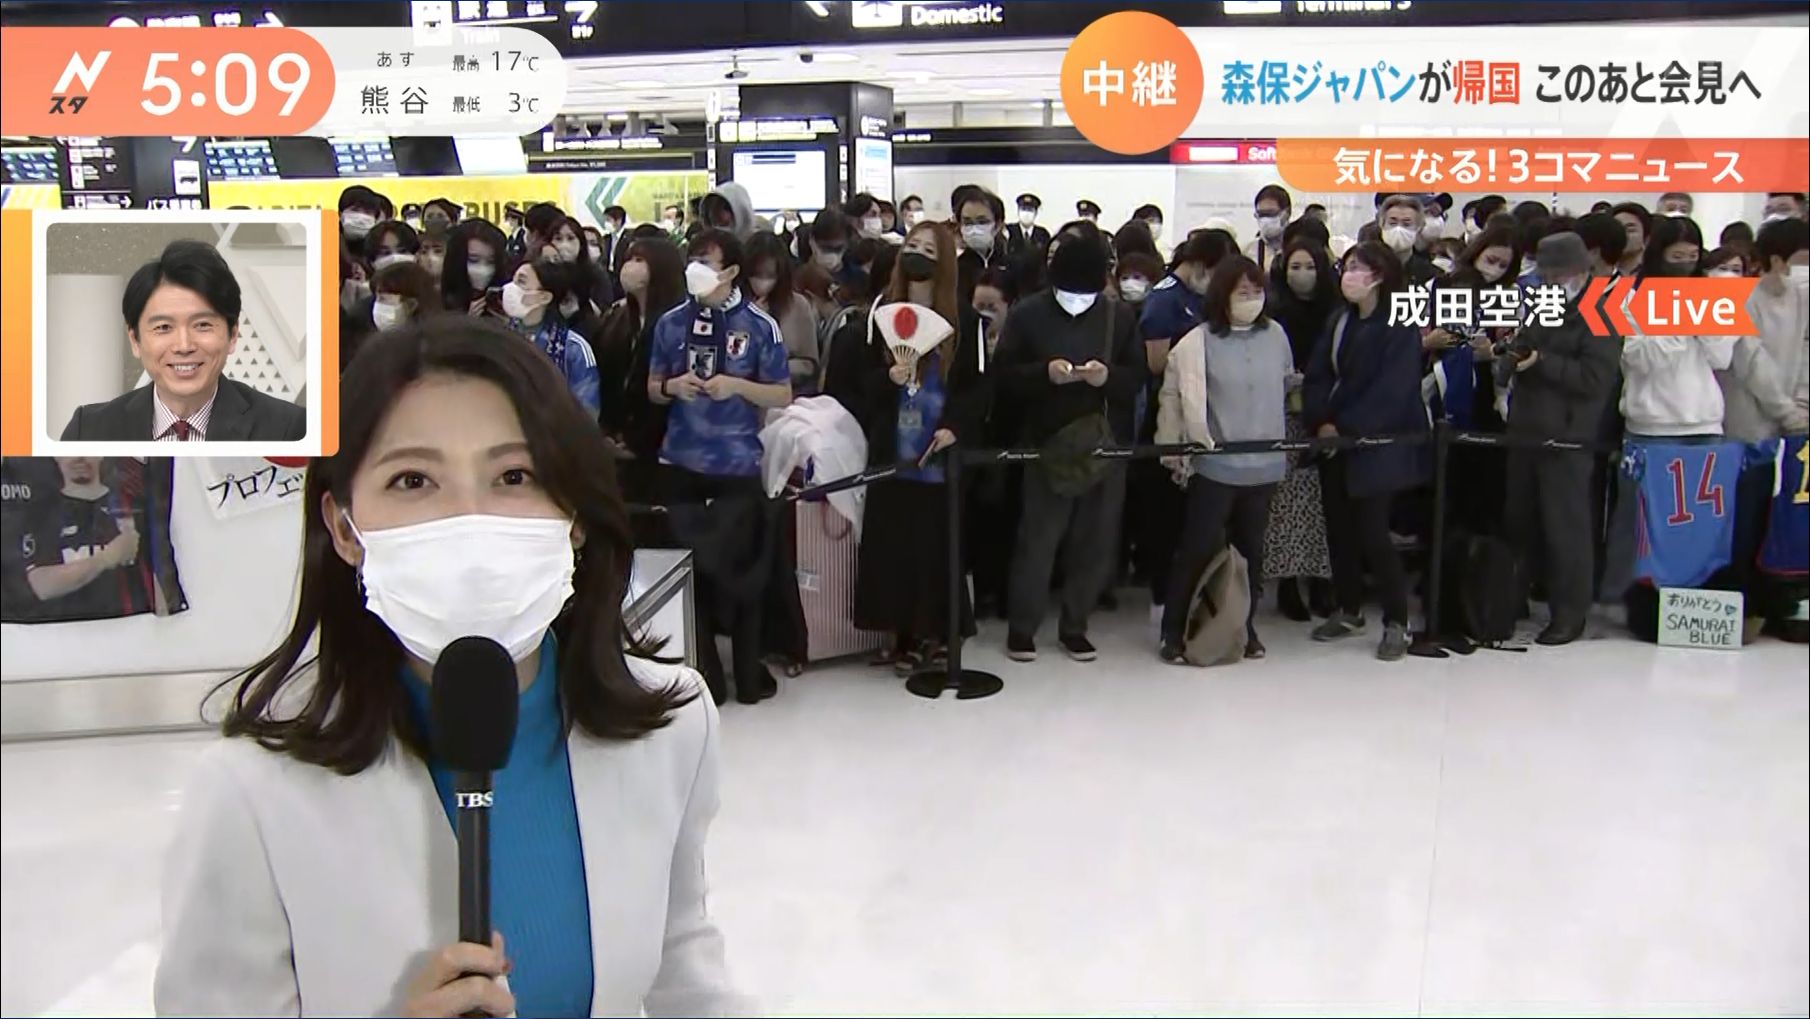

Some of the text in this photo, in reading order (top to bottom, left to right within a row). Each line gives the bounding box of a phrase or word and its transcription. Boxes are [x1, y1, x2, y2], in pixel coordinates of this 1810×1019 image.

[911, 4, 1003, 26] Domestic
[1667, 452, 1724, 525] 14
[1666, 593, 1722, 613] ありがとう
[1666, 613, 1735, 632] SAMURAI
[1689, 631, 1731, 645] BLUE
[456, 791, 494, 808] TBS
